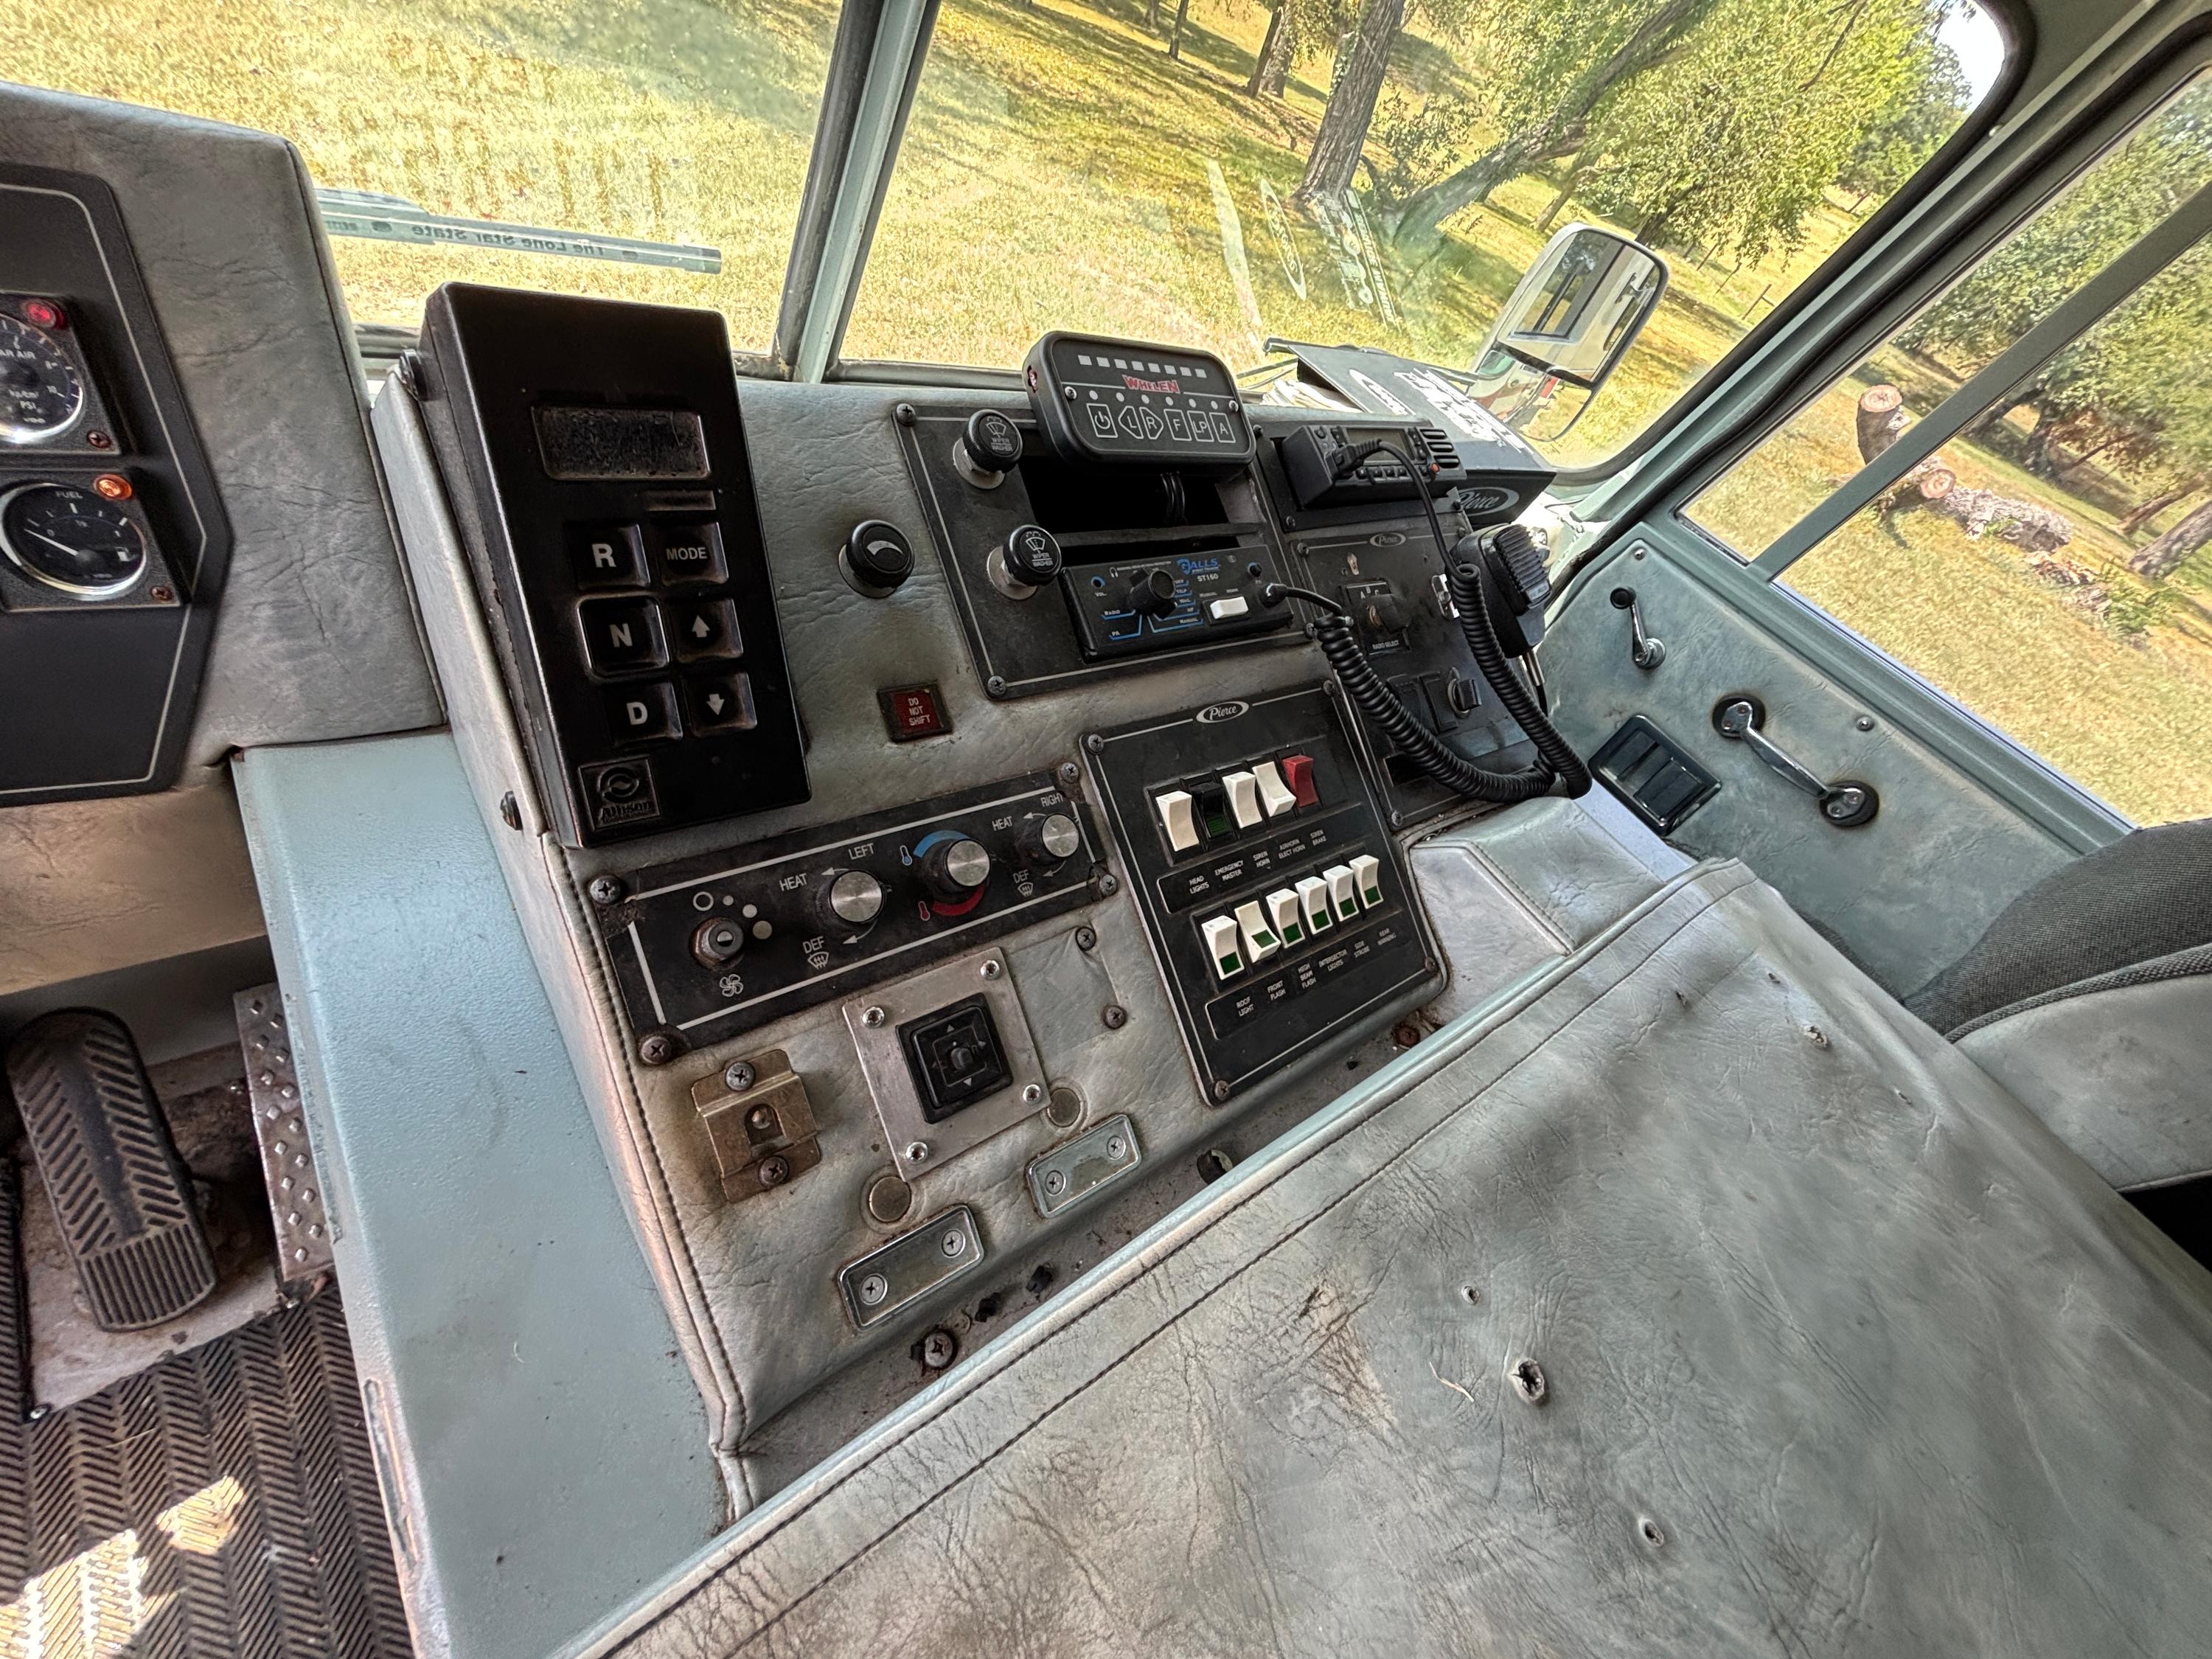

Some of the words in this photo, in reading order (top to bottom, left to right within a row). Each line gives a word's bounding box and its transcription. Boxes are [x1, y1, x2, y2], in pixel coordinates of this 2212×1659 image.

[16, 350, 36, 360] AIR
[1122, 375, 1180, 394] WHELEN
[19, 400, 37, 410] PSI
[1127, 415, 1137, 428] L
[1147, 417, 1158, 429] R
[1173, 419, 1180, 431] F
[1192, 420, 1208, 434] LP
[1220, 422, 1229, 434] A
[55, 491, 83, 499] FUEL
[592, 543, 616, 568] R
[666, 547, 708, 560] MODE
[609, 623, 633, 647] N
[908, 698, 919, 706] DO
[627, 702, 648, 726] D
[909, 706, 923, 715] NOT
[1209, 706, 1237, 720] Pierce
[908, 714, 931, 726] SHIFT
[992, 816, 1012, 831] HEAT
[1310, 830, 1324, 839] SIREN
[848, 843, 874, 860] LEFT
[1253, 850, 1268, 861] SIREN
[1279, 849, 1293, 859] ELECT
[1293, 844, 1306, 854] HORN
[1214, 860, 1244, 876] EMERGENCY
[1256, 858, 1270, 868] HORN
[1013, 869, 1029, 883] DEF
[1189, 875, 1204, 885] HEAD
[1222, 869, 1242, 881] MASTER
[779, 872, 808, 891] HEAT
[1189, 883, 1209, 894] LIGHTS
[803, 936, 824, 954] DEF
[1354, 945, 1370, 958] STROBE
[1298, 963, 1310, 973] HIGH
[1327, 959, 1344, 972] LIGHTS
[1300, 970, 1313, 981] BEAM
[1267, 980, 1283, 993] FRONT
[1301, 977, 1316, 989] FLASH
[1270, 988, 1286, 1001] FLASH
[1236, 996, 1251, 1008] ROOF
